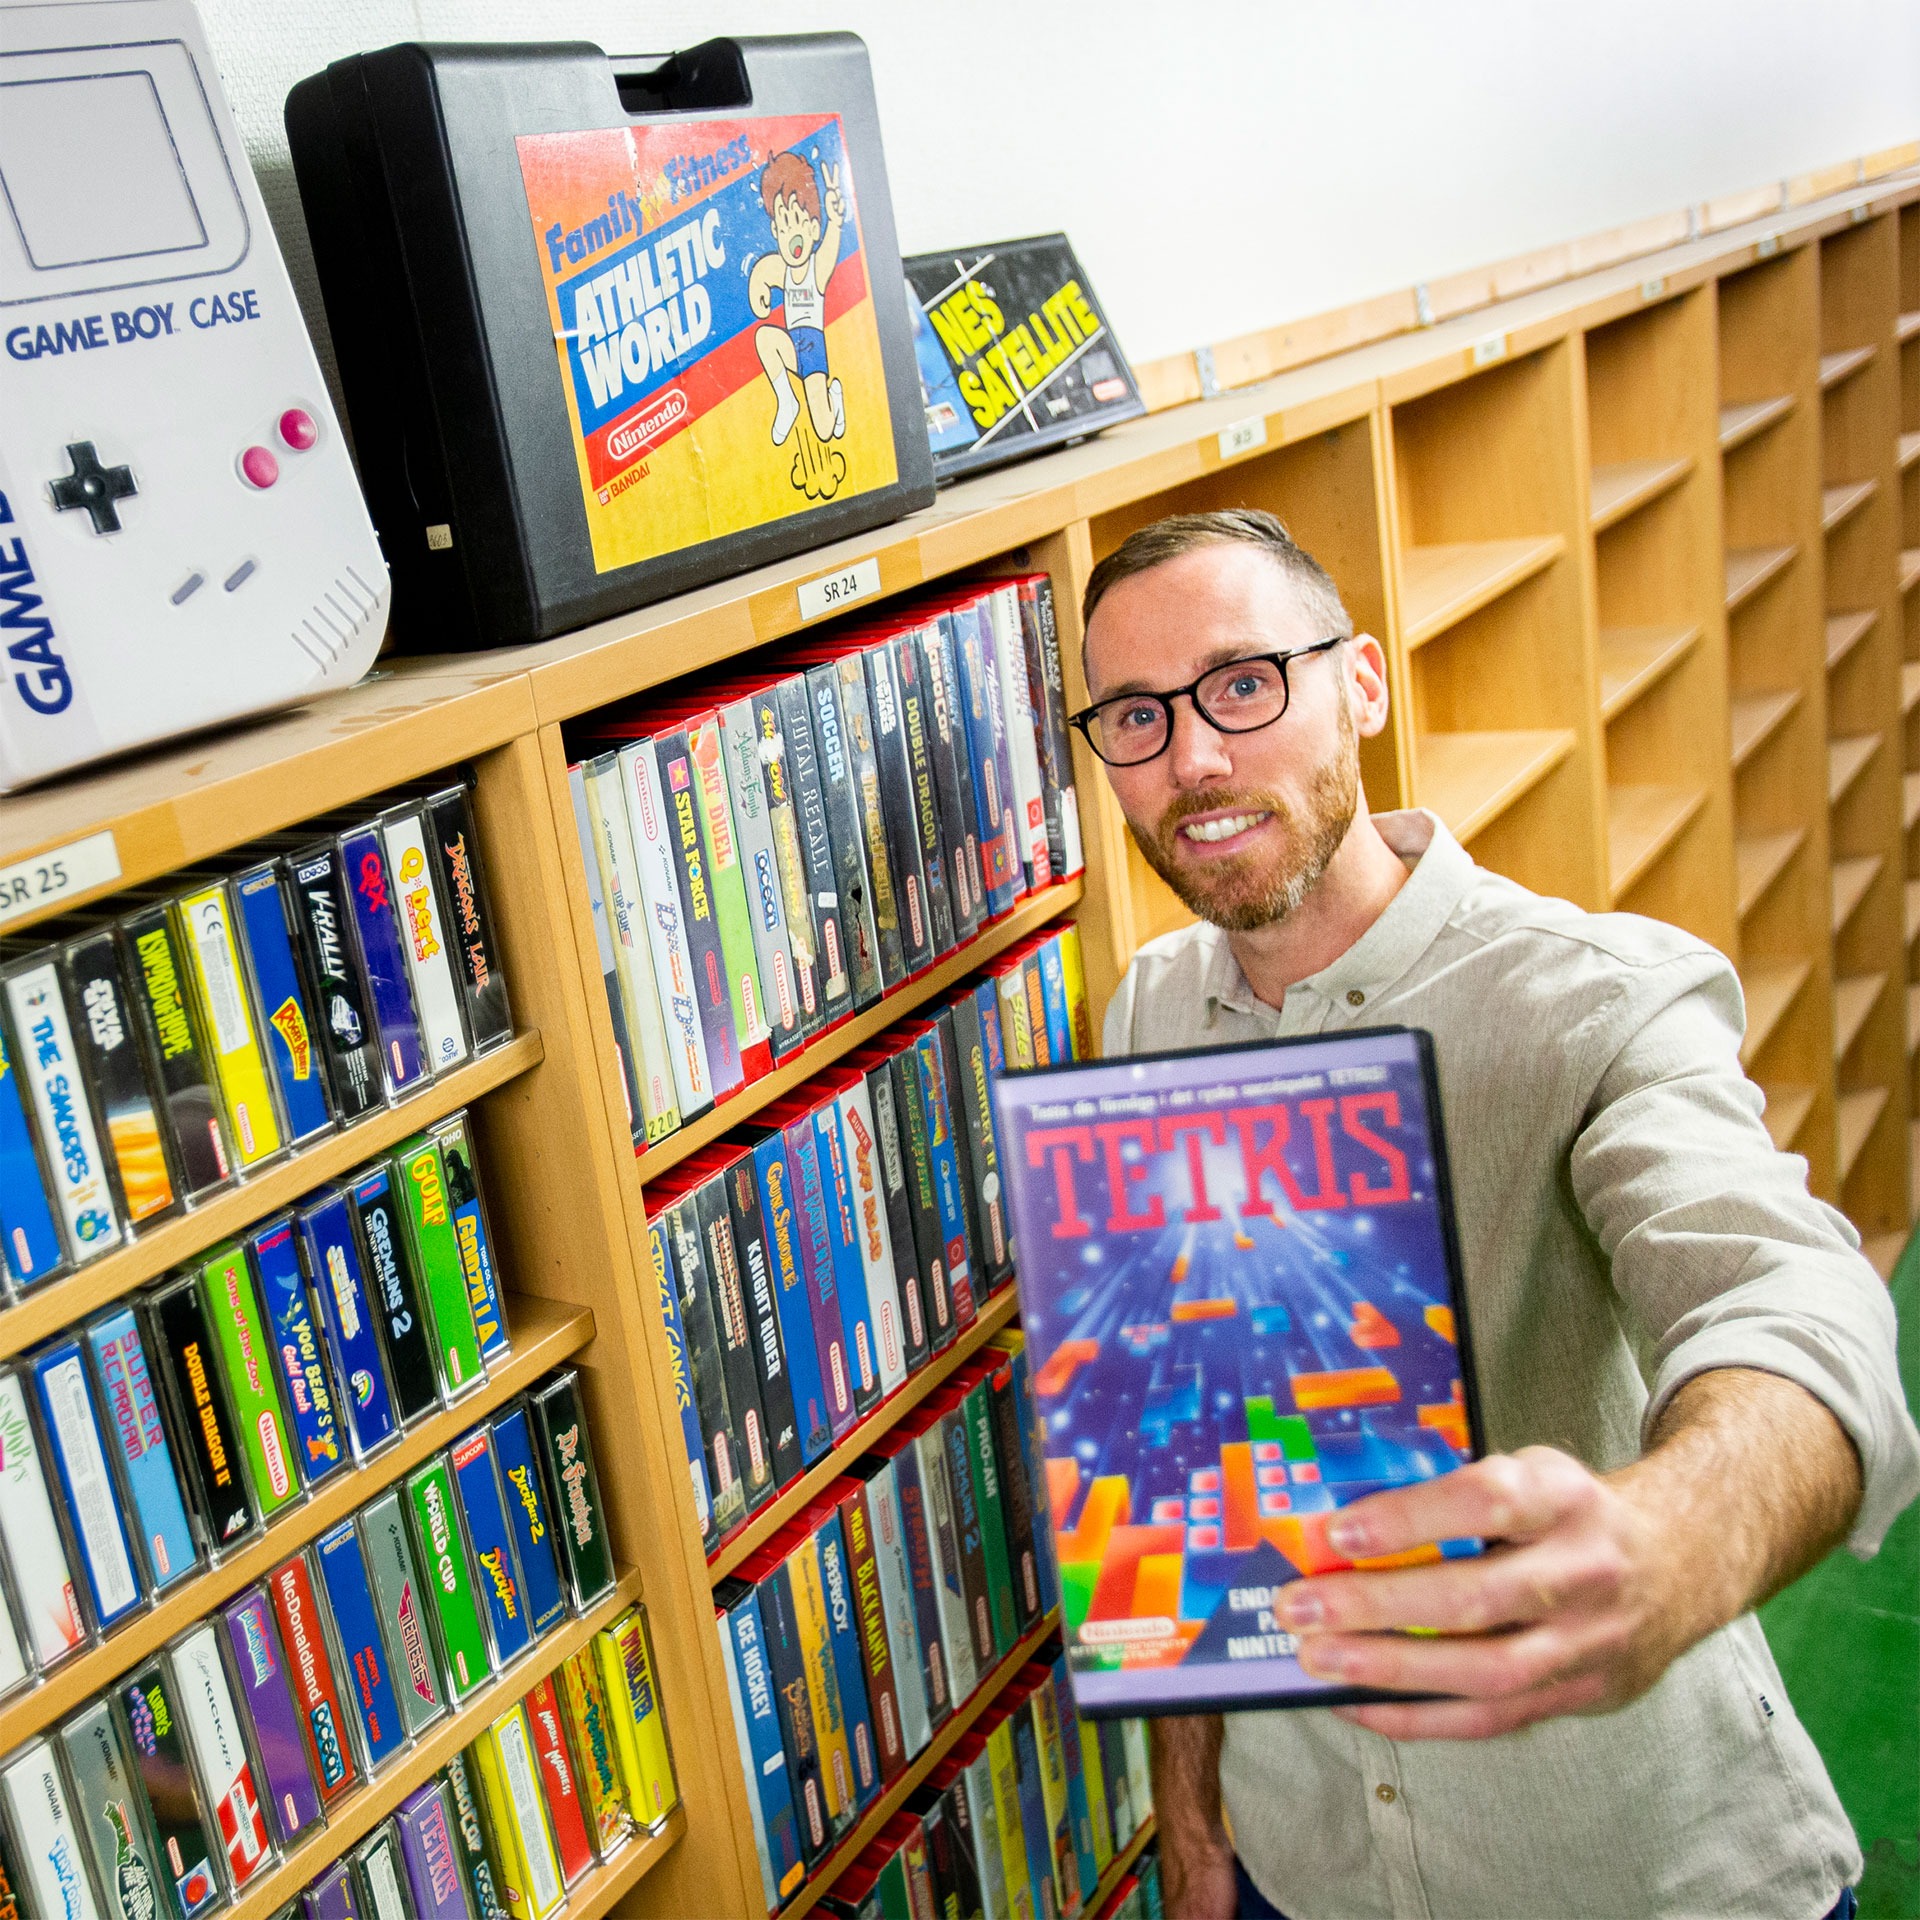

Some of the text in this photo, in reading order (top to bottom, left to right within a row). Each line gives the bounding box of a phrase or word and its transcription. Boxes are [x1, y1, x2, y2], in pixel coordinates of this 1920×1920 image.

[545, 134, 753, 274] Family Fitness
[573, 207, 728, 351] ATHLETIC
[5, 315, 109, 361] GAME
[189, 289, 261, 329] CASE
[580, 282, 712, 410] WORLD
[928, 279, 1006, 366] NES
[958, 279, 1101, 429] SATELLITE
[612, 397, 683, 454] Nintendo
[611, 461, 651, 498] BANDAI
[0, 536, 74, 716] GAME
[823, 574, 858, 604] SR 24
[817, 687, 845, 782] SOCCER
[906, 697, 926, 771] DOUBLE
[917, 771, 936, 850] DRAGON
[637, 763, 655, 838] Nintendo
[710, 808, 733, 866] DUEL
[803, 788, 830, 875] RECALL
[0, 860, 69, 910] SR 25
[300, 861, 330, 881] ocean
[675, 791, 710, 921] STAR FORCE
[307, 890, 349, 983] V-RALLY
[444, 831, 491, 999] DRAGON'S LAIR
[618, 909, 631, 932] GUN
[774, 954, 793, 1027] Nintendo
[32, 1015, 63, 1070] THE
[275, 1003, 308, 1076] ROGER RABBIT
[849, 1113, 869, 1149] SUPER
[1024, 1090, 1412, 1239] TETRIS
[411, 1153, 447, 1229] GOLF
[364, 1213, 384, 1284] THE NEW BATCH
[371, 1207, 413, 1340] GREMLINS 2
[479, 1245, 488, 1268] TOHO
[224, 1266, 261, 1392] King of the Zoo
[747, 1238, 782, 1381] KNIGHT RIDER
[881, 1302, 898, 1371] Nintendo
[120, 1329, 164, 1450] SUPER
[282, 1344, 312, 1414] Gold Rush
[292, 1318, 333, 1428] YOGI BEAR'S
[830, 1341, 848, 1413] Nintendo
[855, 1320, 874, 1392] Nintendo
[184, 1341, 208, 1408] DOUBLE
[199, 1402, 228, 1469] DRAGON
[261, 1415, 285, 1493] Nintendo
[454, 1441, 484, 1467] CAPCOM
[746, 1409, 765, 1485] Nintendo
[977, 1417, 998, 1498] PRO-AM
[422, 1480, 457, 1594] WORLD CUP
[507, 1464, 545, 1545] DUCKTALES 2
[394, 1536, 406, 1575] KONAMI
[480, 1545, 518, 1621] DUCKTALES
[850, 1506, 888, 1677] WRATH BLACK MANTA
[280, 1569, 323, 1706] McDonaldland
[400, 1597, 431, 1692] NEMESIS
[620, 1625, 654, 1725] DYNABLASTER
[736, 1613, 772, 1721] ICE HOCKEY
[146, 1684, 173, 1737] KIRBY'S
[314, 1703, 346, 1785] ocean
[100, 1739, 118, 1782] KONAMI
[537, 1709, 572, 1797] MARBLE MADNESS
[42, 1771, 63, 1821] KONAMI
[48, 1834, 73, 1883] TINY
[419, 1800, 458, 1907] TETRIS
